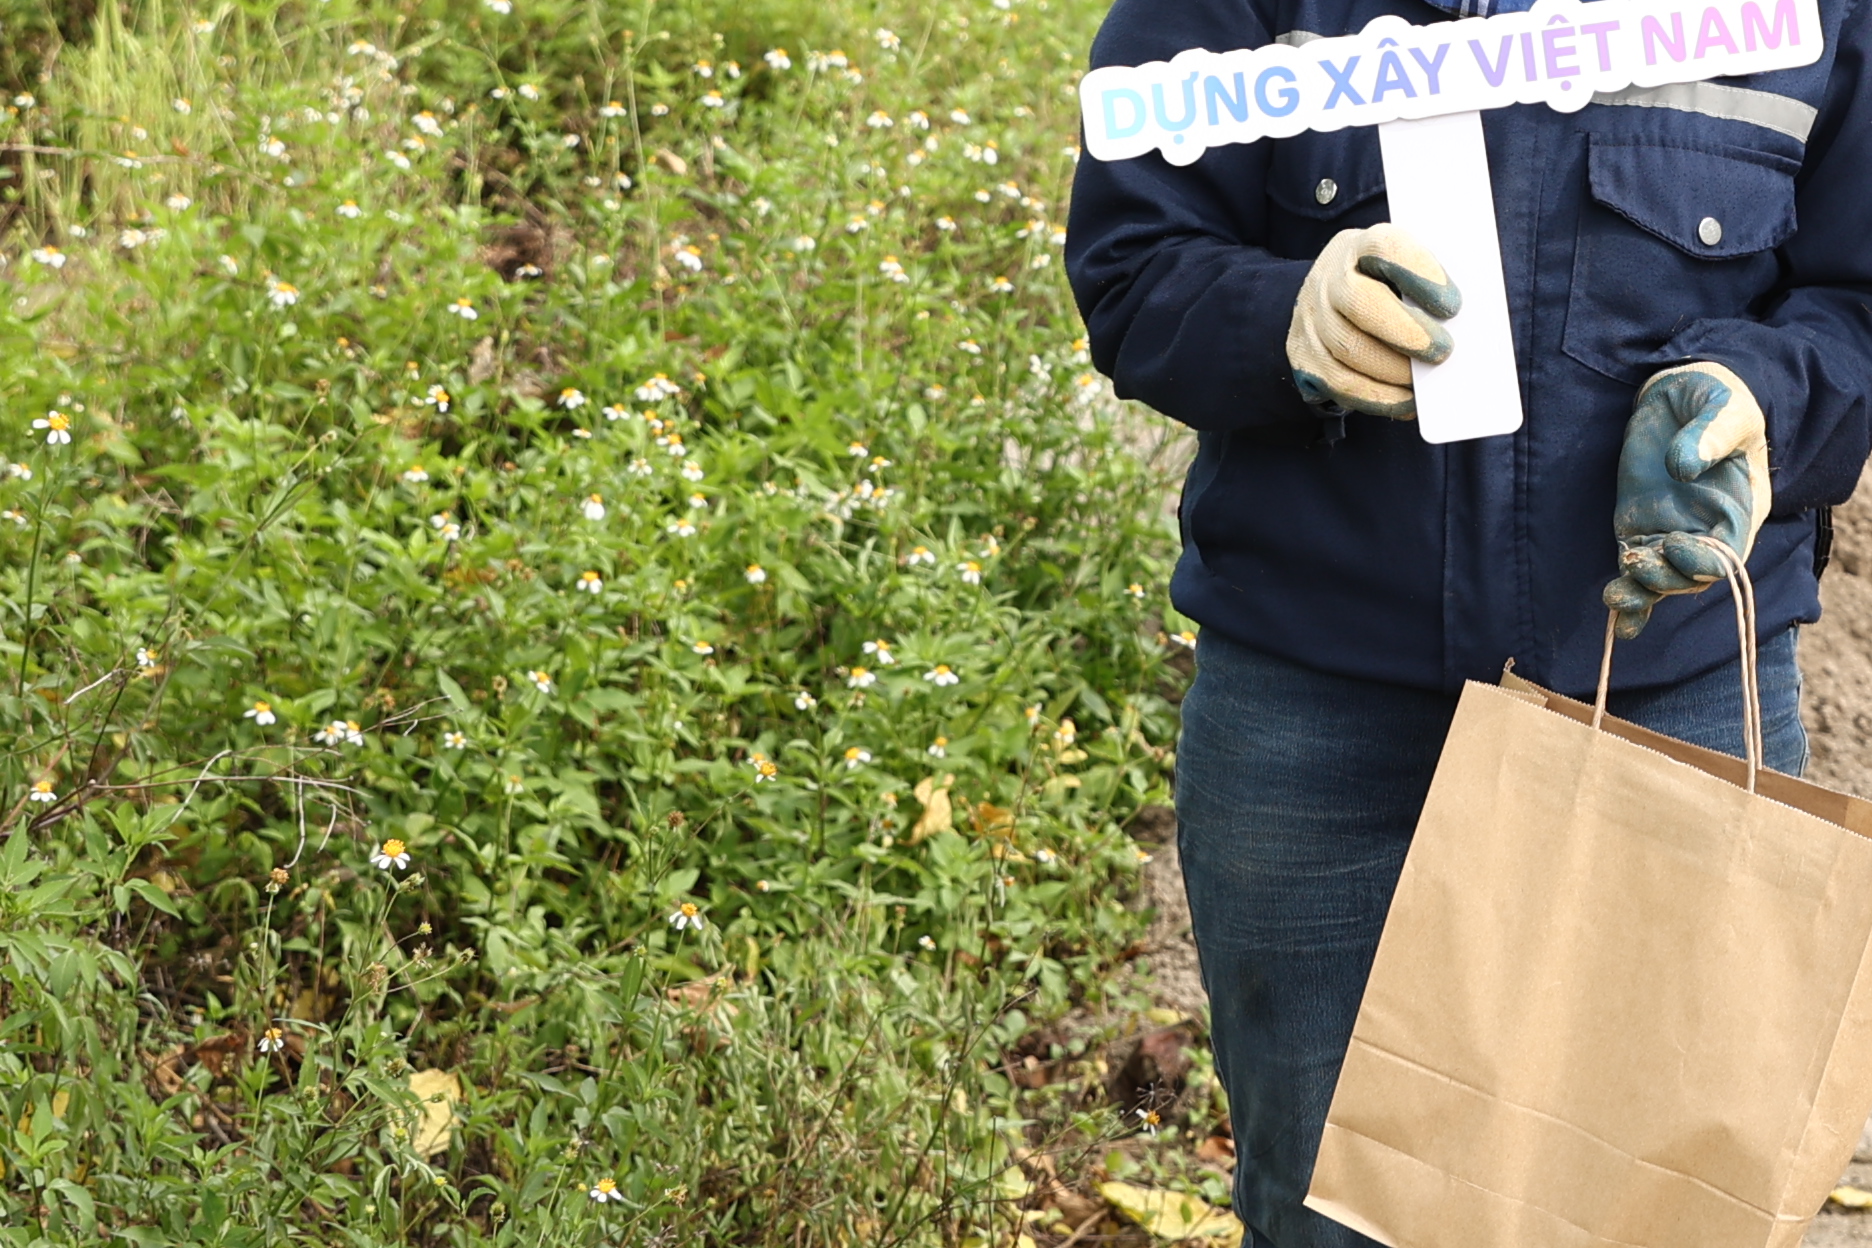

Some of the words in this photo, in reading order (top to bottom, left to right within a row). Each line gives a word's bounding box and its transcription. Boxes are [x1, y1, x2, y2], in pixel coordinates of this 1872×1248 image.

[1101, 64, 1301, 145] DỰNG
[1317, 36, 1451, 110] XÂY
[1467, 14, 1622, 91] VIỆT
